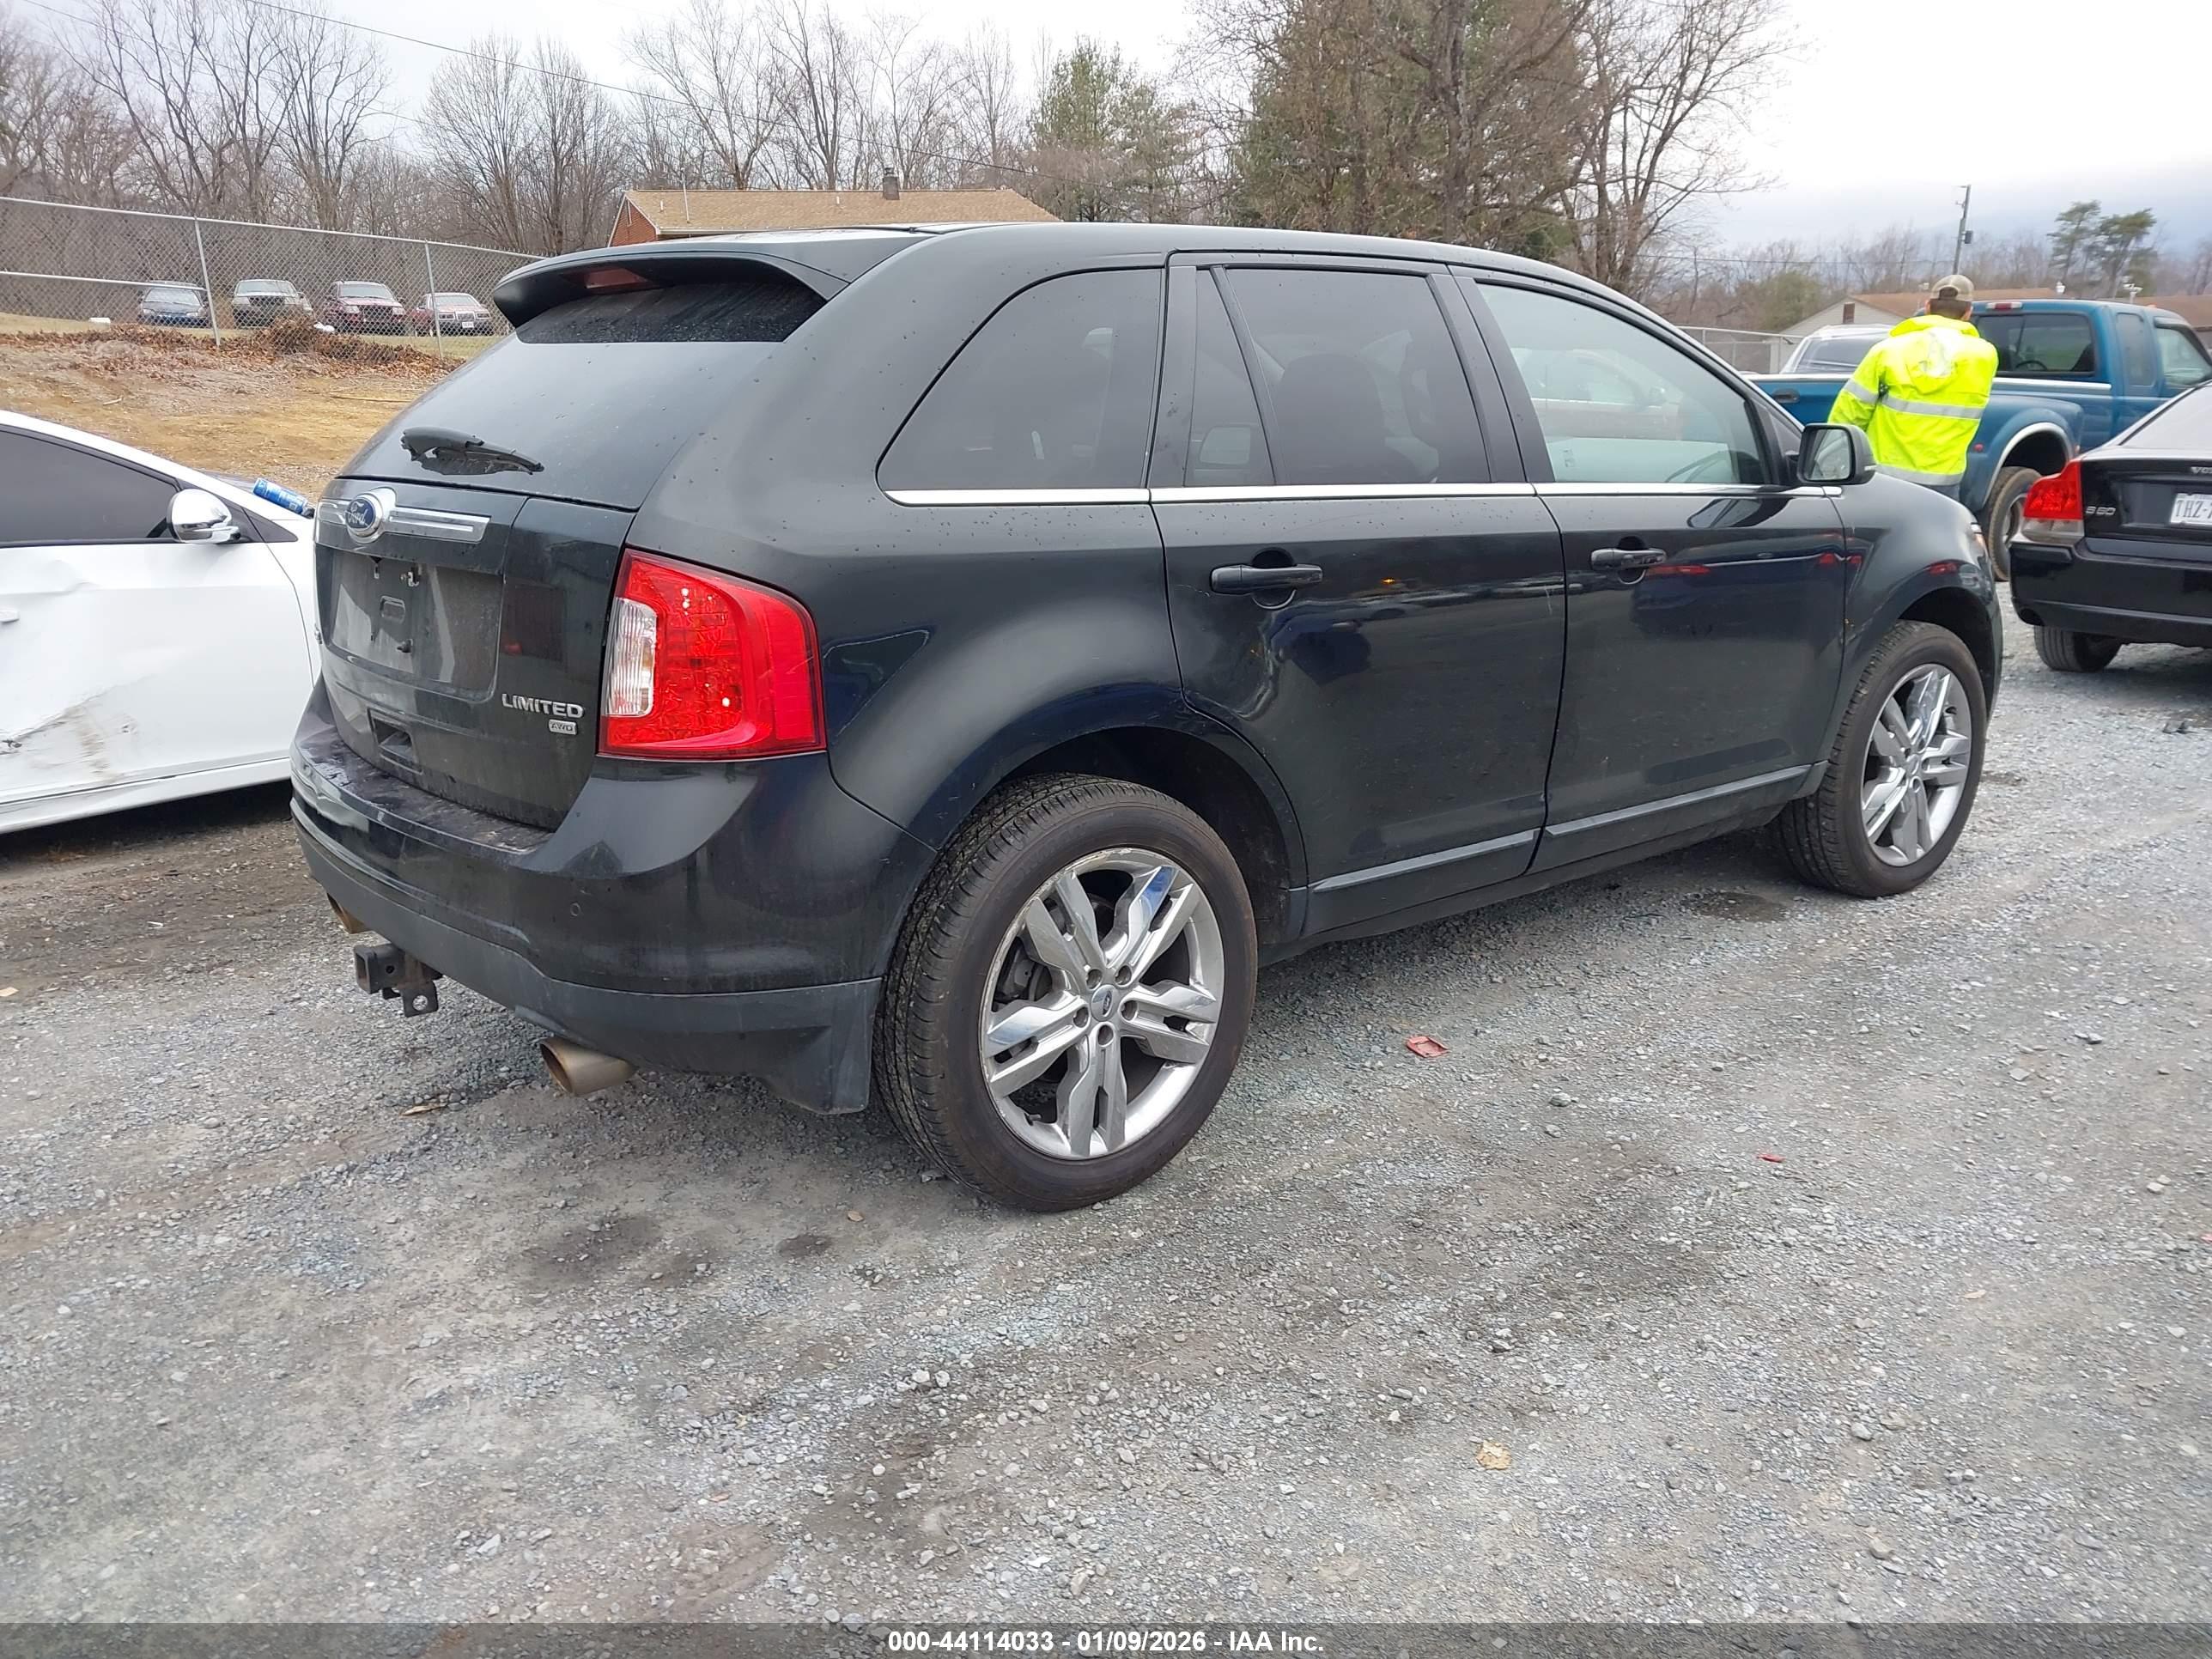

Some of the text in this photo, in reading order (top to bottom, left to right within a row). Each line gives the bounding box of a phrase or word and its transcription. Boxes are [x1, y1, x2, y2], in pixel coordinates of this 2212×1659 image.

[345, 501, 370, 526] Ford
[501, 693, 584, 718] LIMITED
[551, 723, 574, 732] AWD
